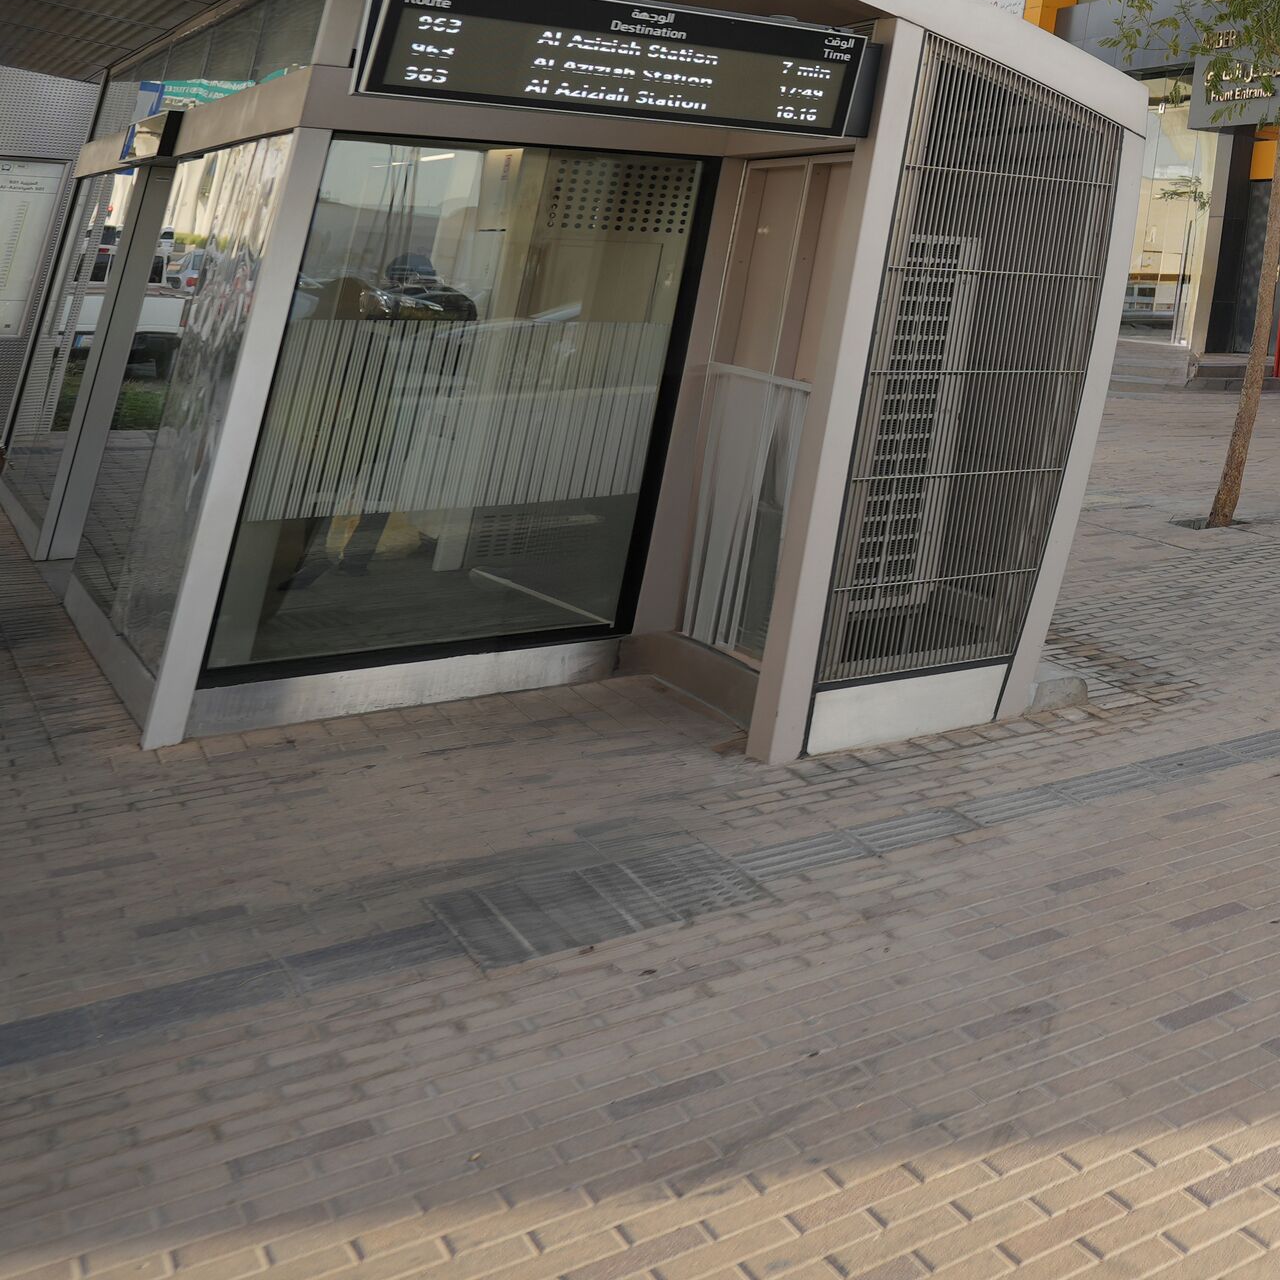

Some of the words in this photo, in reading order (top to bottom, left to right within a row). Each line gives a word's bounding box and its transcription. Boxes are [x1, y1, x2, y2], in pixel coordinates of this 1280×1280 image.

[631, 8, 675, 25] الوجهة
[610, 20, 687, 40] Destination
[825, 35, 855, 49] الوقت
[537, 30, 562, 46] Al
[569, 34, 641, 58] Aziziah
[648, 44, 718, 67] Station
[782, 61, 793, 74] 7
[797, 65, 831, 80] min
[823, 48, 851, 62] Time
[643, 69, 713, 88] Station
[524, 79, 550, 94] Al
[635, 90, 707, 111] Station
